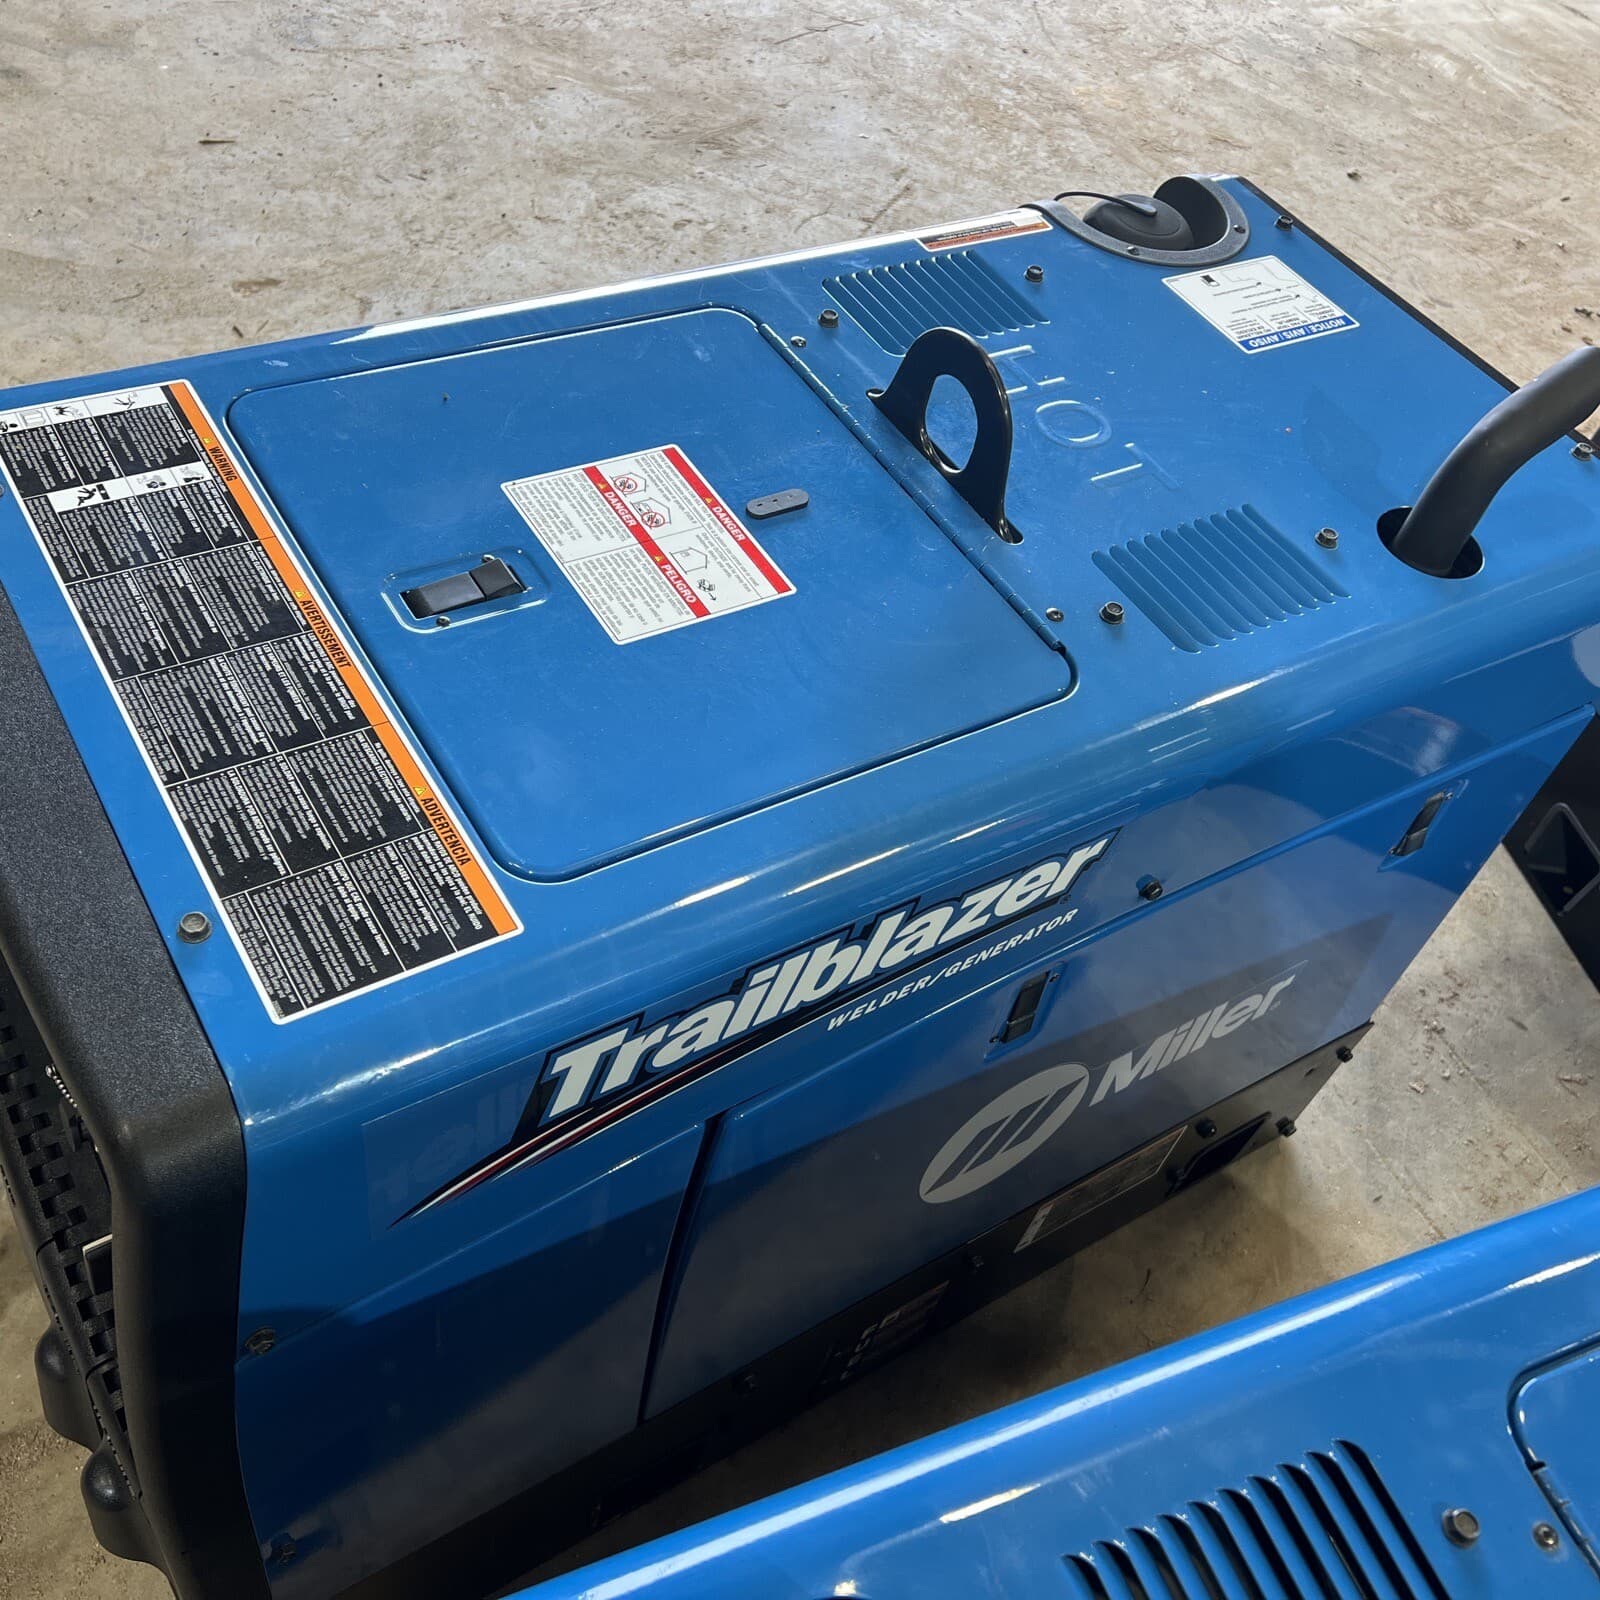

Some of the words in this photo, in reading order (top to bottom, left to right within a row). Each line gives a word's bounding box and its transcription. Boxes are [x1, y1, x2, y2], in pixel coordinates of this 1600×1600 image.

[1248, 334, 1279, 347] AVISO
[1285, 327, 1306, 339] AVIS
[1310, 319, 1346, 333] NOTICE
[207, 445, 239, 482] WARNING
[603, 490, 637, 528] DANGER
[711, 505, 746, 542] DANGER
[660, 563, 697, 605] PELIGRO
[300, 600, 351, 668] AVERTISSEMENT
[420, 797, 471, 866] ADVERTENCIA
[547, 838, 1111, 1119] Trailblazer
[826, 908, 1079, 1032] WELDER/GENERATOR
[1088, 974, 1296, 1107] Miller
